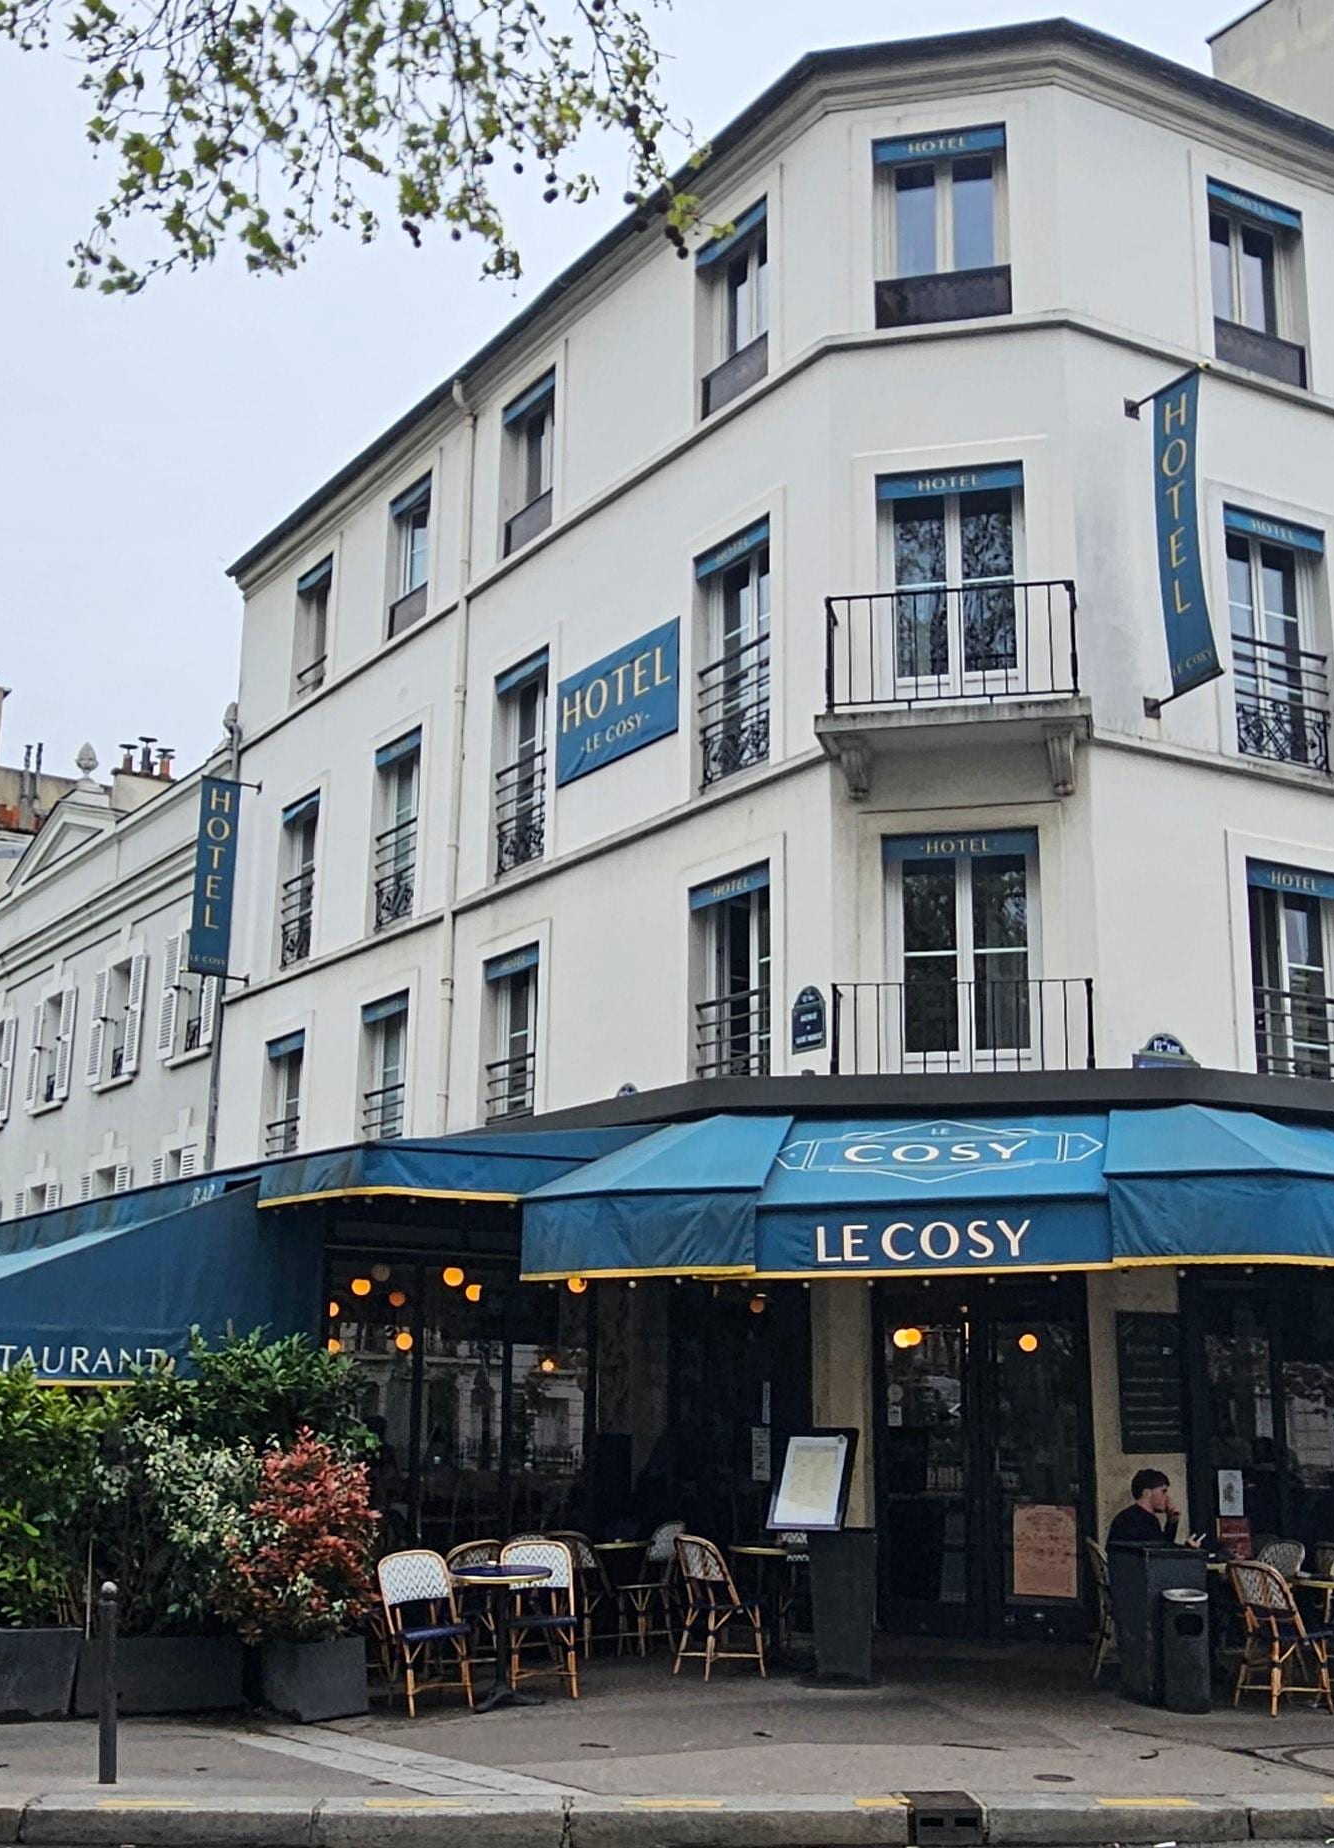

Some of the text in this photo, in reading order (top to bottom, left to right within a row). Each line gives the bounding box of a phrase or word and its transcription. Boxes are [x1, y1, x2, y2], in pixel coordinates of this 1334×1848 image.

[907, 136, 966, 154] HOTEL
[918, 474, 981, 492] HOTEL
[1162, 392, 1191, 615] HOTEL
[1250, 519, 1295, 541] HOTEL
[562, 647, 671, 733] HOTEL
[586, 711, 644, 753] LE COSY
[926, 837, 991, 855] HOTEL
[204, 787, 230, 929] HOTEL
[712, 876, 749, 898] HOTEL
[1270, 870, 1319, 892] HOTEL
[931, 1128, 950, 1136] LE
[845, 1140, 1028, 1162] COSY
[817, 1219, 1031, 1263] LE COSY
